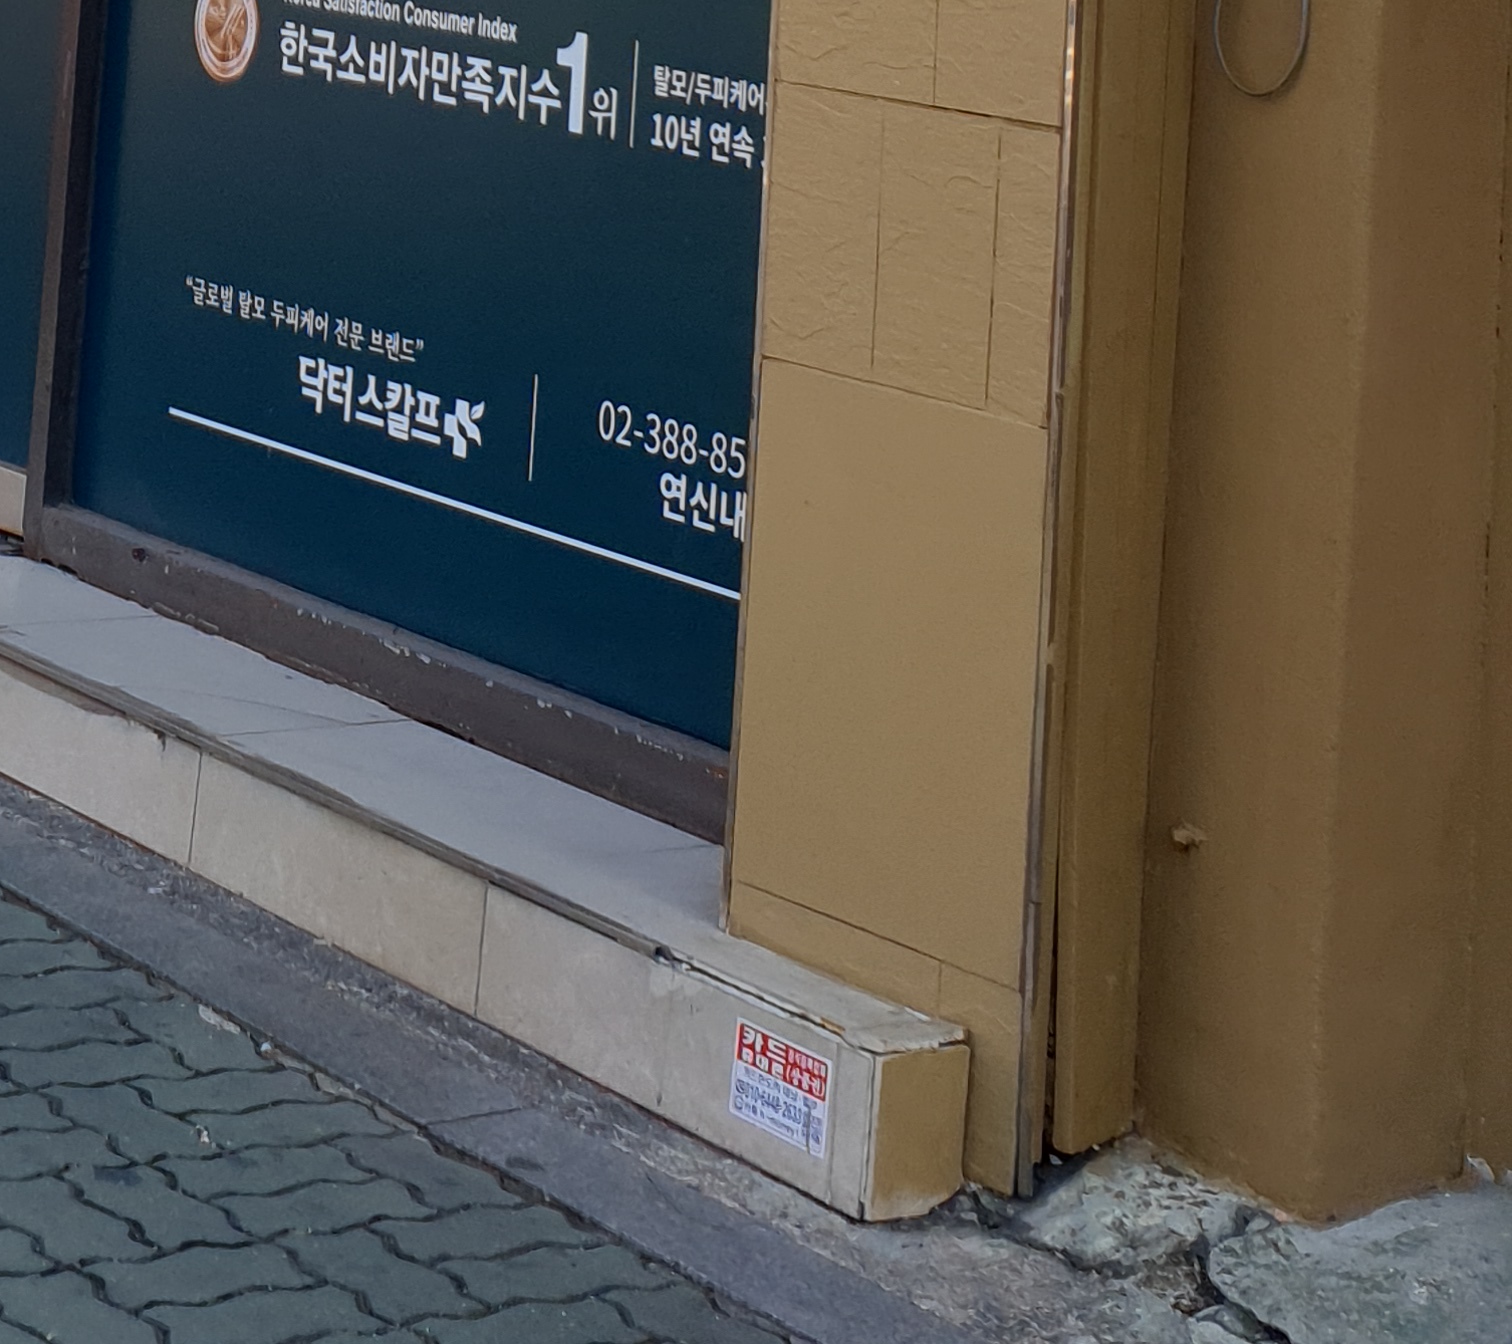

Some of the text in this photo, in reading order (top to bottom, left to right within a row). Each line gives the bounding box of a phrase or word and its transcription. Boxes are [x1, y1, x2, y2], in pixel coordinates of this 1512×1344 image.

[403, 0, 475, 37] Consumer
[478, 12, 518, 44] Index
[650, 112, 756, 170] 10년 연속
[238, 289, 266, 320] 탈모
[270, 300, 329, 342] 두피케어
[334, 317, 365, 352] 전문
[659, 471, 748, 543] 연신내
